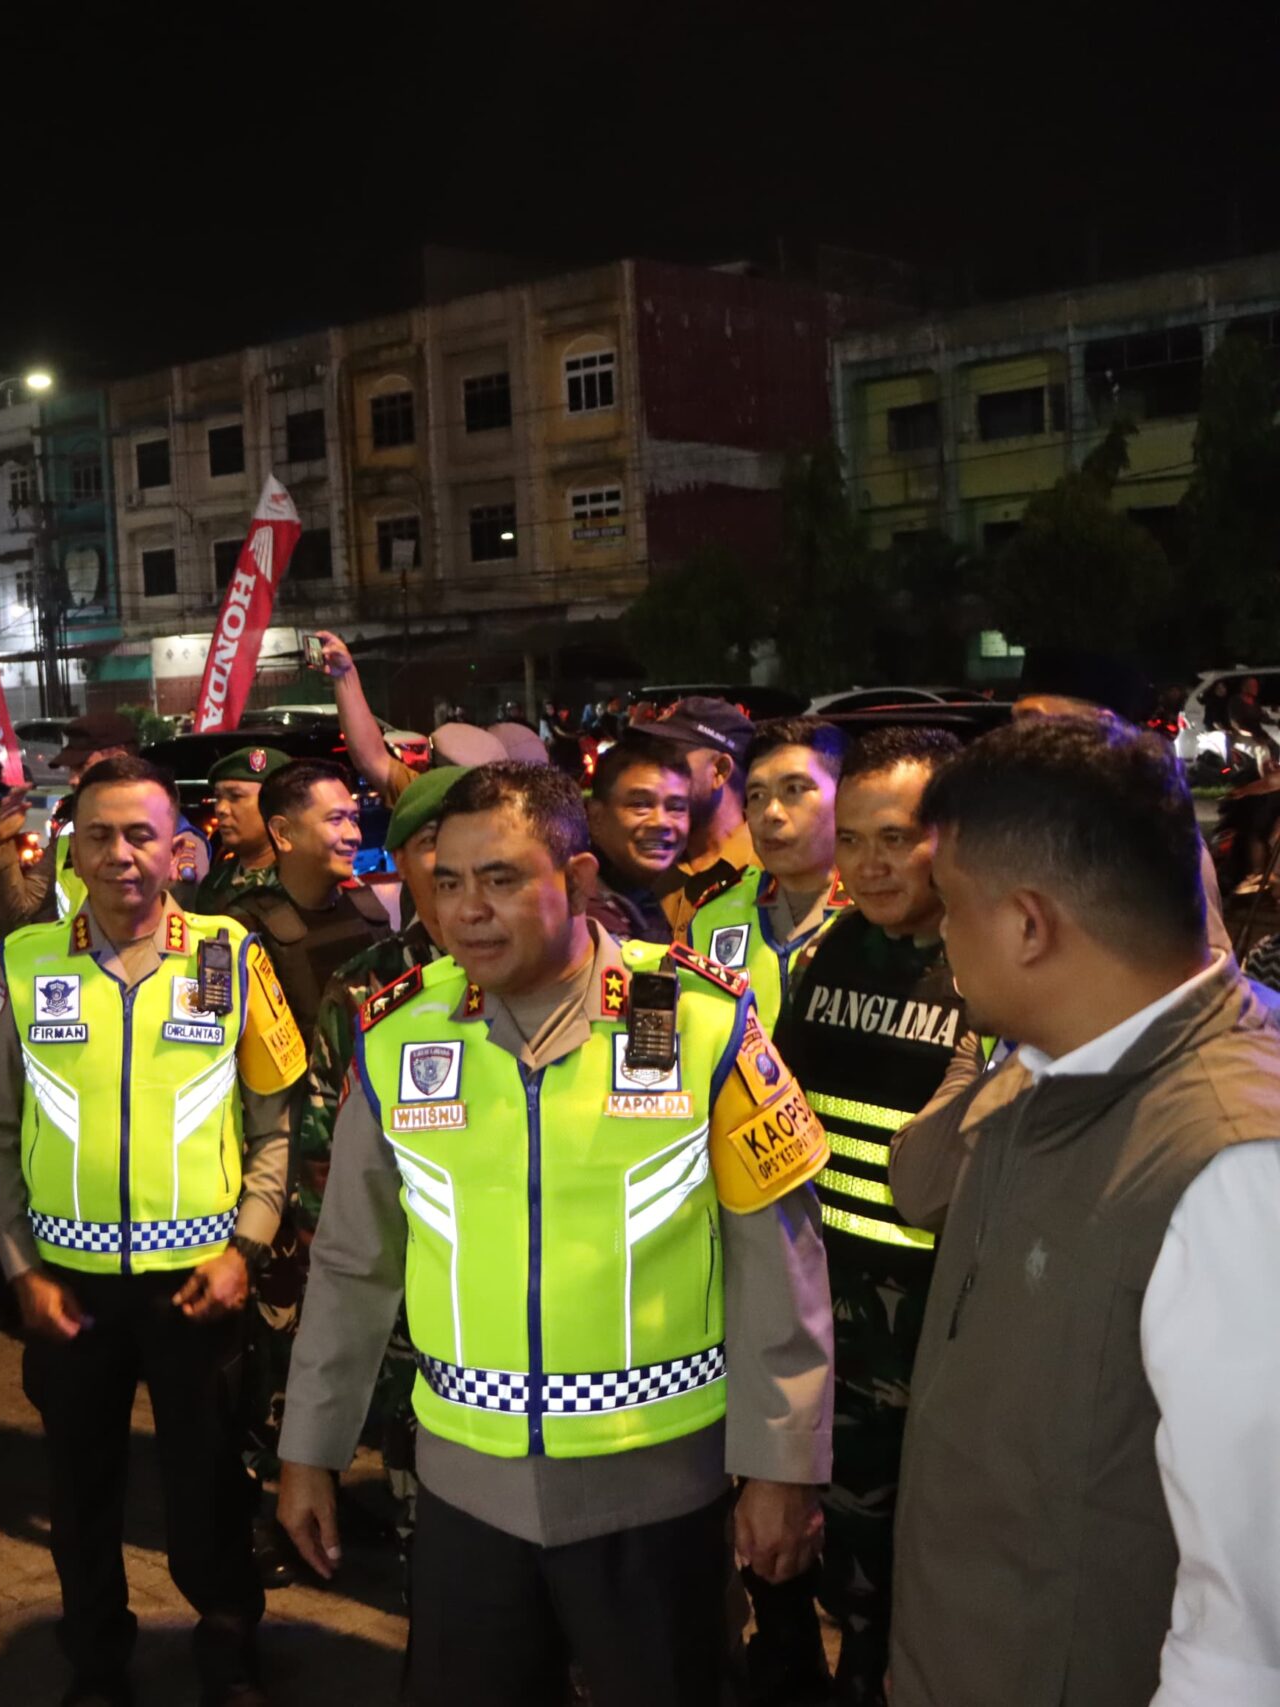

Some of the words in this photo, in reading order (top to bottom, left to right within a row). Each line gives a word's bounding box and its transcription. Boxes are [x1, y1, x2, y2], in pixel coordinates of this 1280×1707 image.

[200, 567, 256, 733] HONDA
[804, 984, 960, 1048] PANGLIMA
[33, 1026, 84, 1039] FIRMAN
[611, 1096, 686, 1112] KAPOLDA
[396, 1106, 460, 1125] WHISNU
[758, 1155, 780, 1180] OPS
